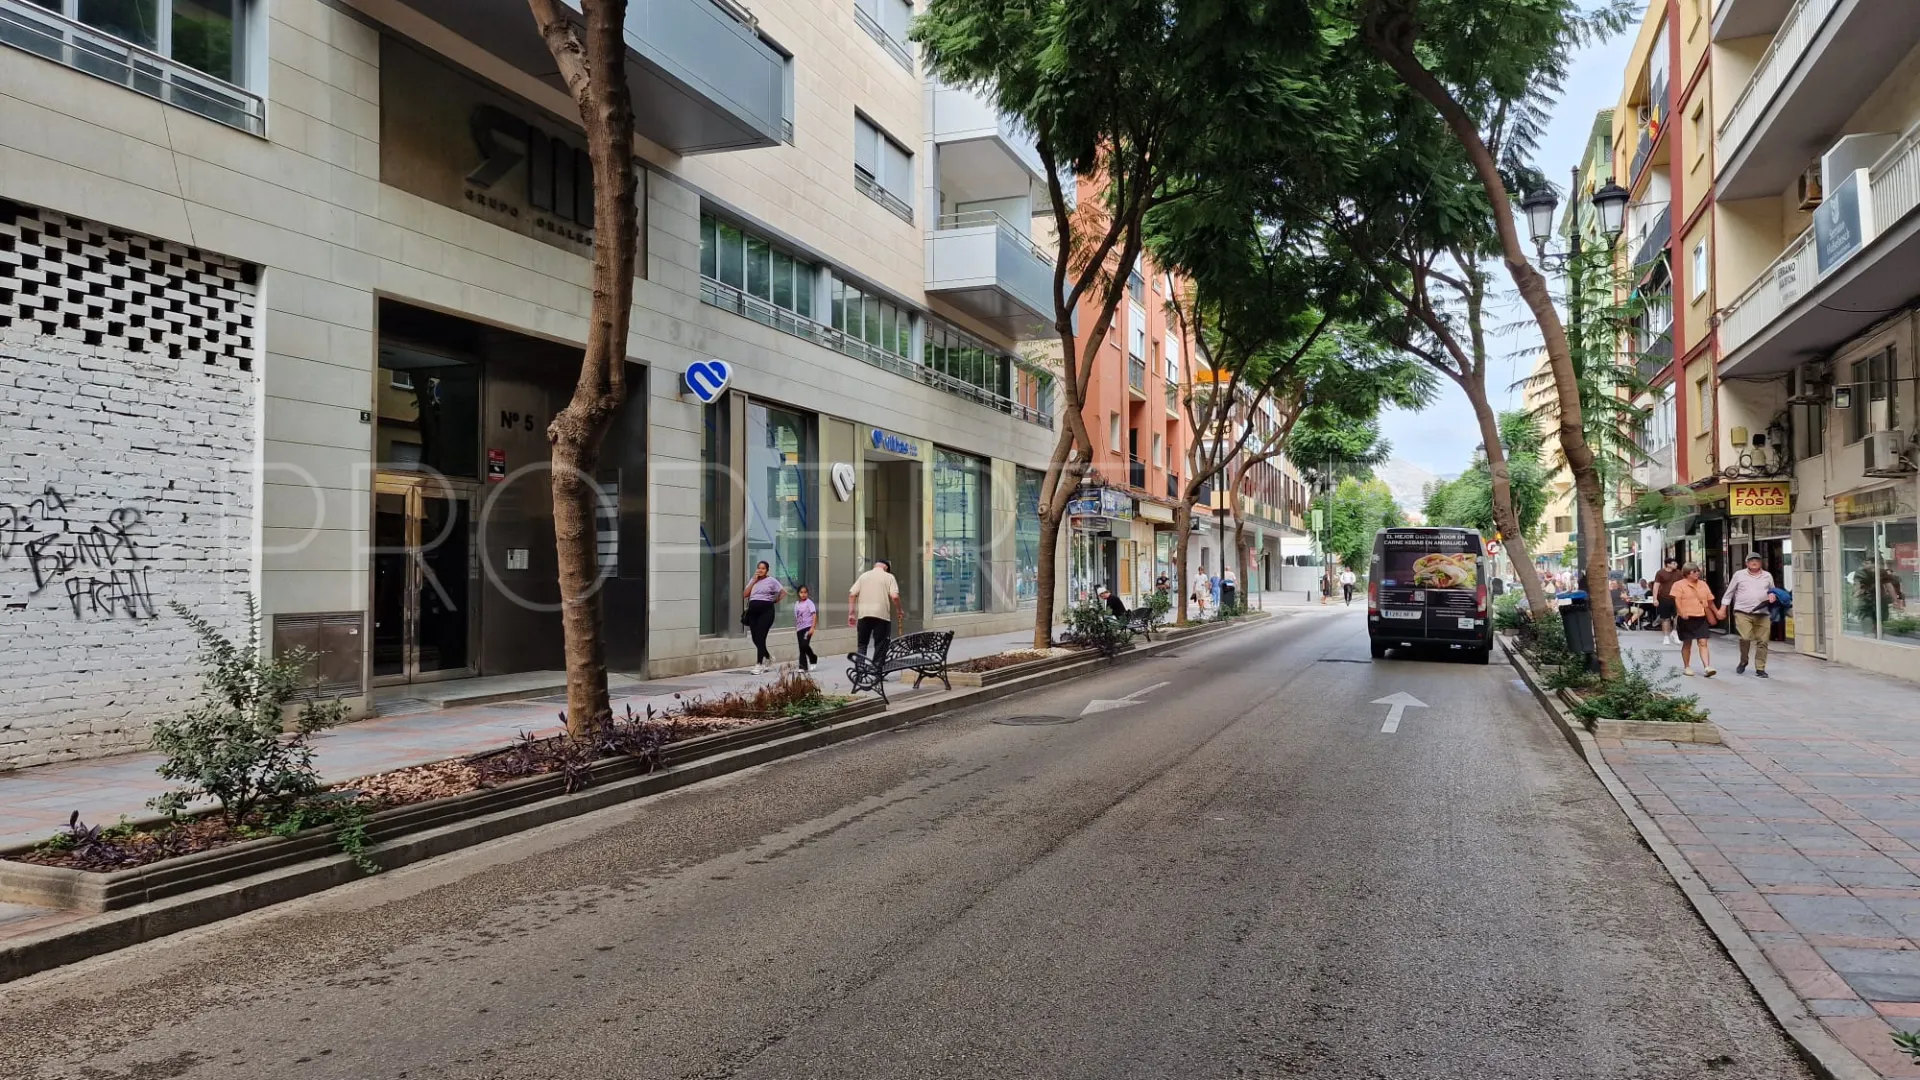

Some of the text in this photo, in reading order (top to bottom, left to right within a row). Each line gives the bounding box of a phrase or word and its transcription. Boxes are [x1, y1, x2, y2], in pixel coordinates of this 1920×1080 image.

[465, 189, 519, 217] GRUPO
[524, 413, 534, 431] 5
[1736, 487, 1783, 498] FAFA
[1736, 498, 1784, 507] FOODS
